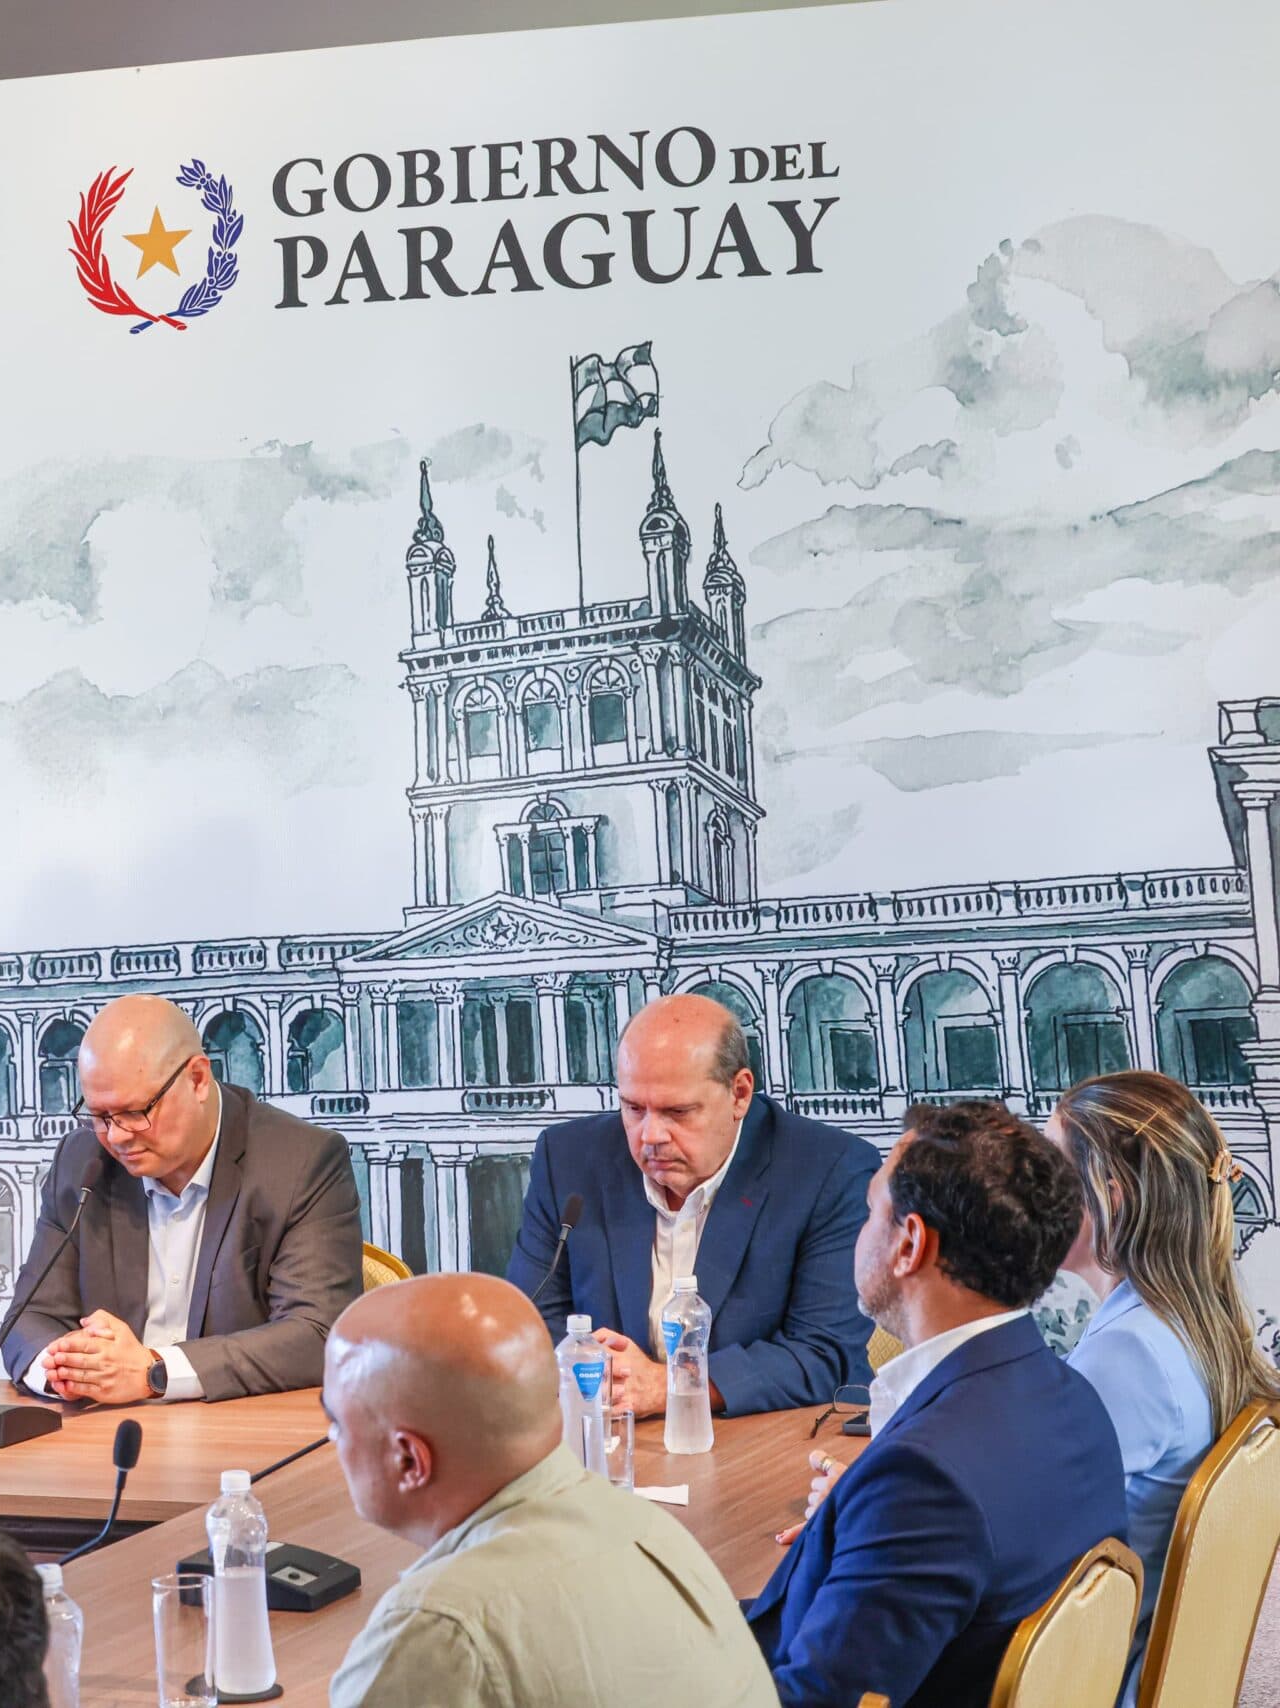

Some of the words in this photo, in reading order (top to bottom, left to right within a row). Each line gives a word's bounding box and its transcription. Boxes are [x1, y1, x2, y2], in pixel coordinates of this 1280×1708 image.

[272, 126, 718, 218] GOBIERNO
[728, 141, 841, 184] DEL
[273, 196, 841, 310] PARAGUAY
